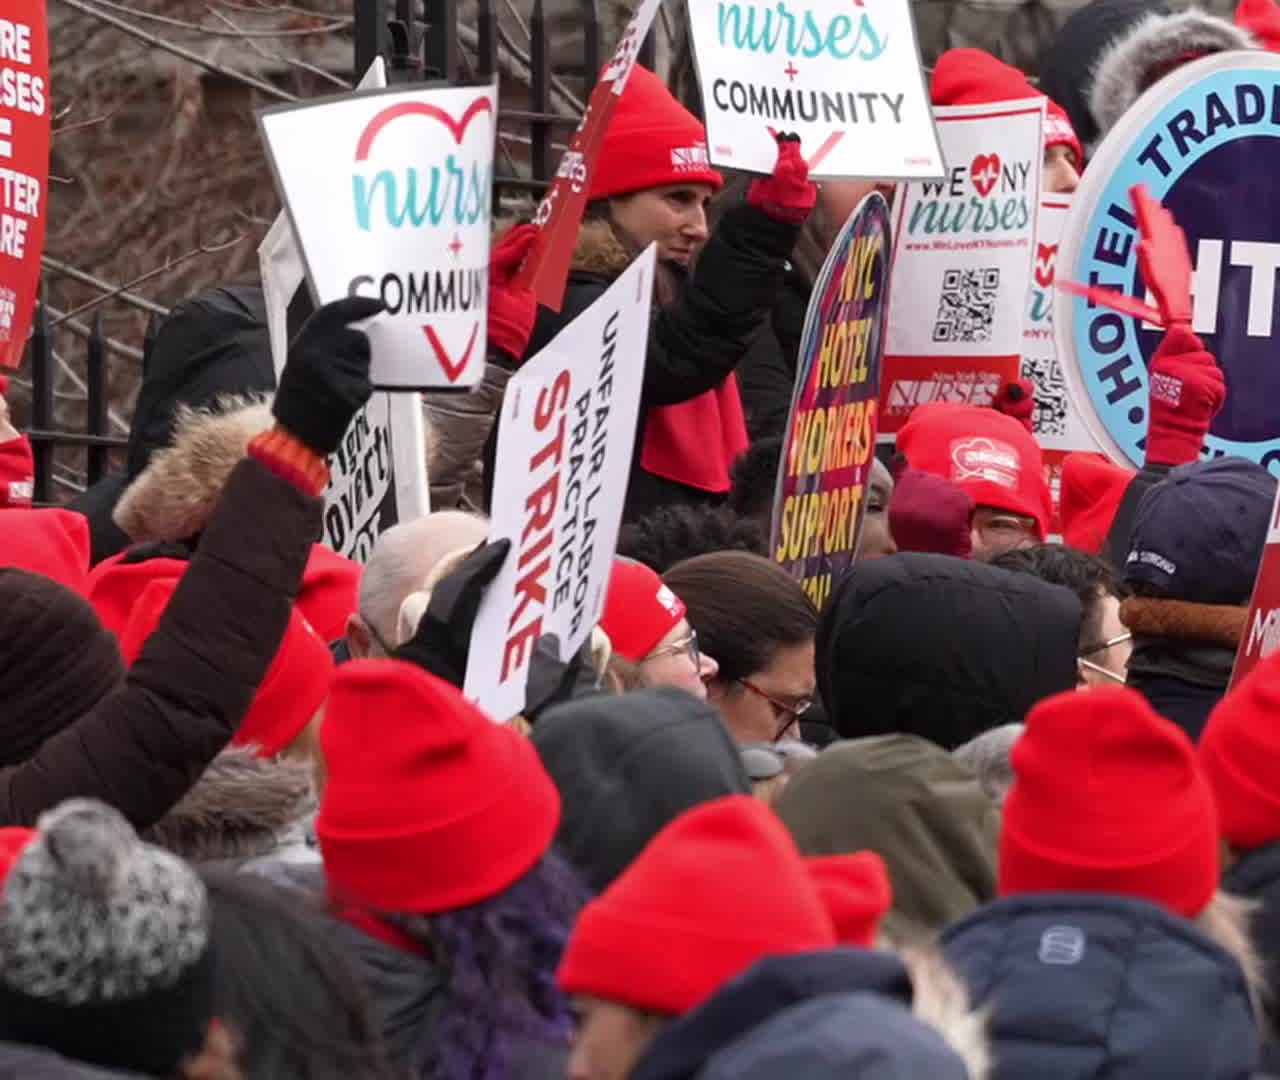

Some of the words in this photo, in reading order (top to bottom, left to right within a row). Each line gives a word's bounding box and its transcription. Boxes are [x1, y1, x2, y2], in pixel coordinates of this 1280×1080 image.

[717, 0, 889, 62] nurses
[712, 77, 905, 124] COMMUNITY
[907, 194, 1030, 236] nurses
[1001, 160, 1032, 196] NY
[840, 234, 883, 304] NYC
[814, 316, 874, 390] HOTEL
[586, 310, 621, 482] UNFAIR
[787, 400, 877, 478] WORKERS
[498, 367, 573, 686] STRIKE
[550, 392, 592, 615] PRACTICE
[775, 483, 865, 566] SUPPORT
